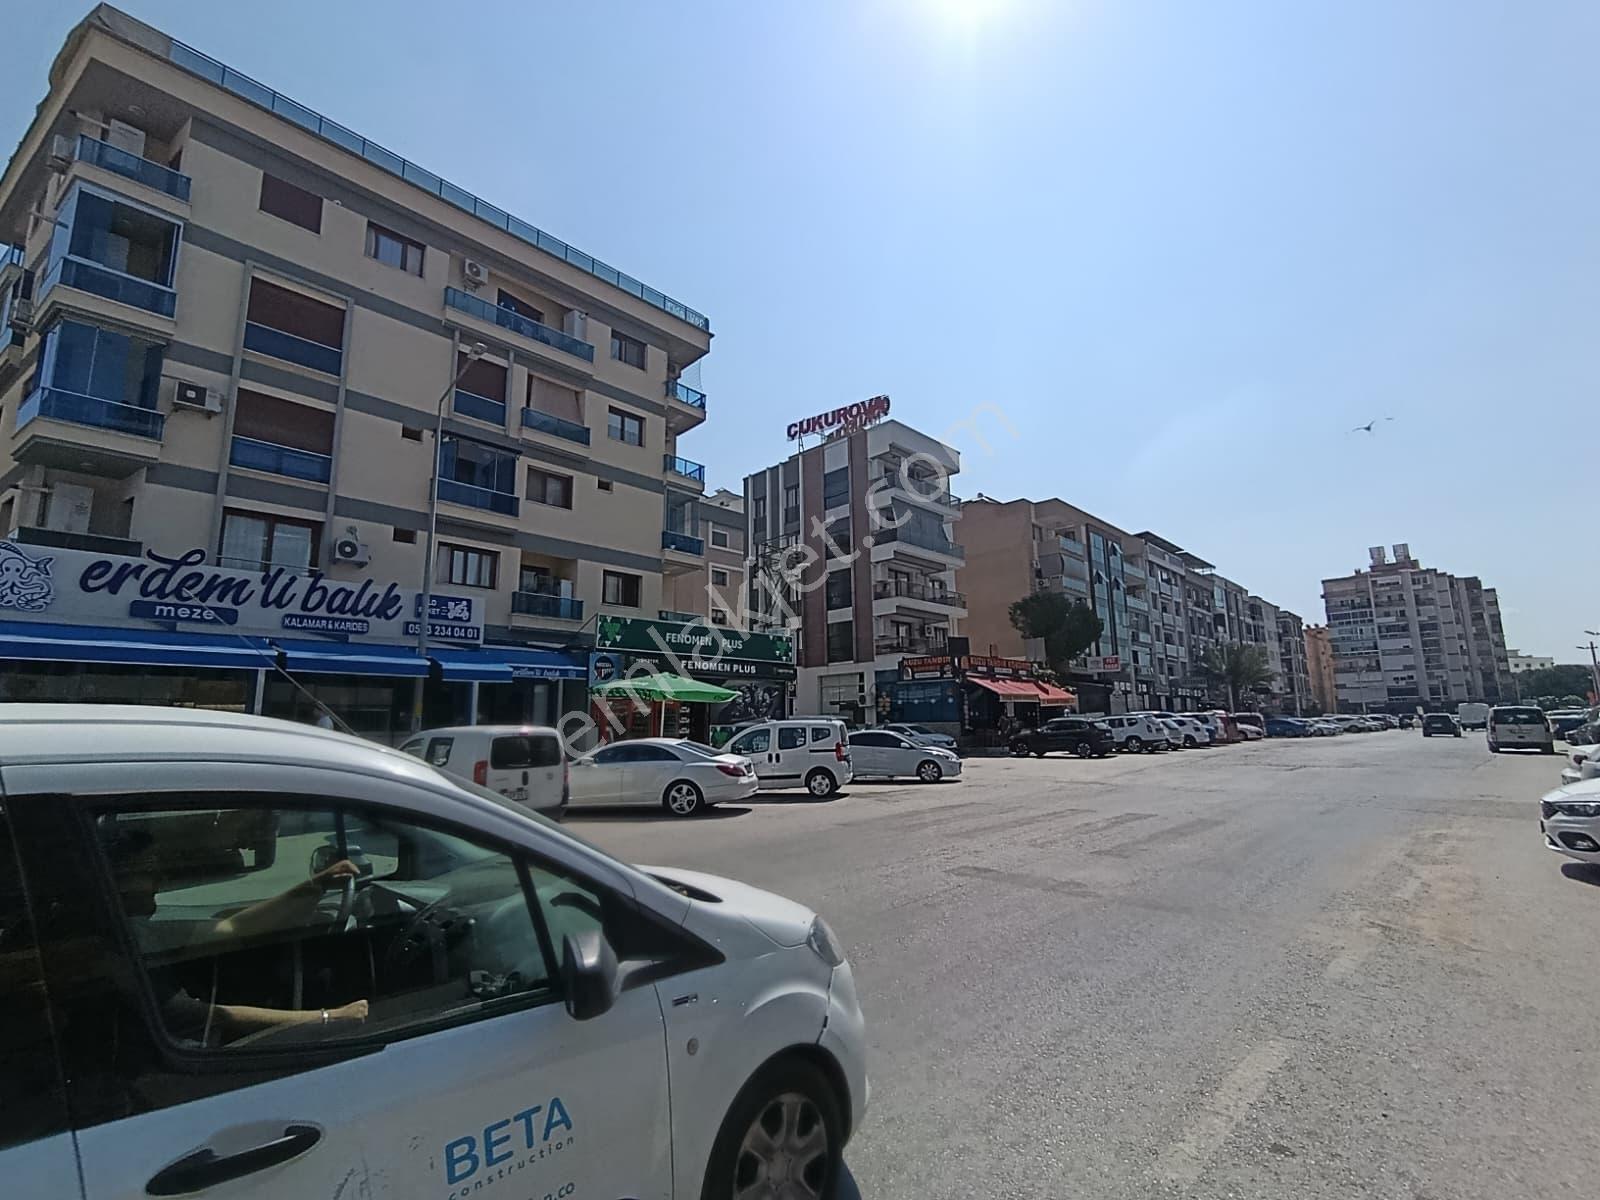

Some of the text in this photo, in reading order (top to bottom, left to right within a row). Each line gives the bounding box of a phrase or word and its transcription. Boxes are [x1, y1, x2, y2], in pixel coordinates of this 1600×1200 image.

[155, 605, 214, 620] meze
[284, 617, 327, 630] KALAMAR
[408, 624, 477, 639] 053 234 04 01
[666, 632, 743, 650] FENOMEN PLUS
[681, 660, 756, 674] FENOMEN PLUS
[445, 1097, 573, 1185] BETA
[448, 1136, 574, 1200] construction
